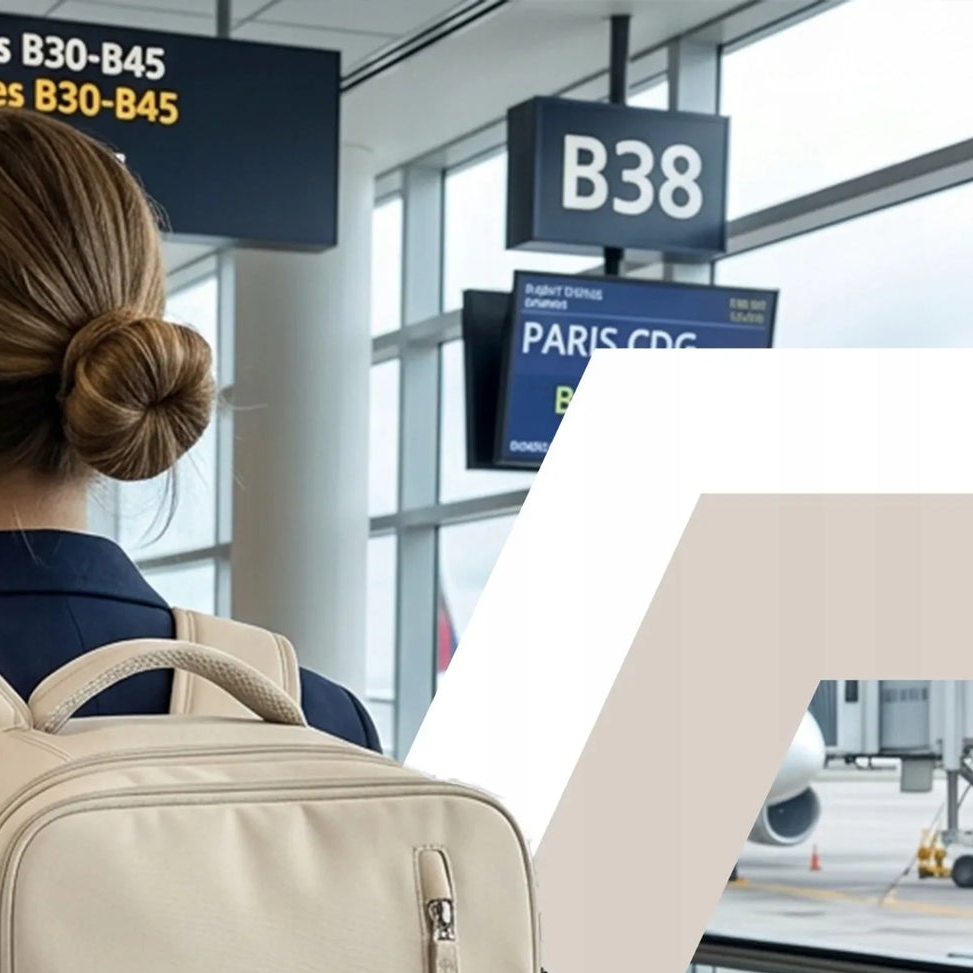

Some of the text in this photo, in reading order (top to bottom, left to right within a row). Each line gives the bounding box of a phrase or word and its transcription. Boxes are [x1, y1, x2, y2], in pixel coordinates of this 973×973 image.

[22, 32, 166, 80] B30-B45
[35, 78, 179, 125] B30-B45
[561, 134, 703, 220] B38
[521, 321, 619, 357] PARIS
